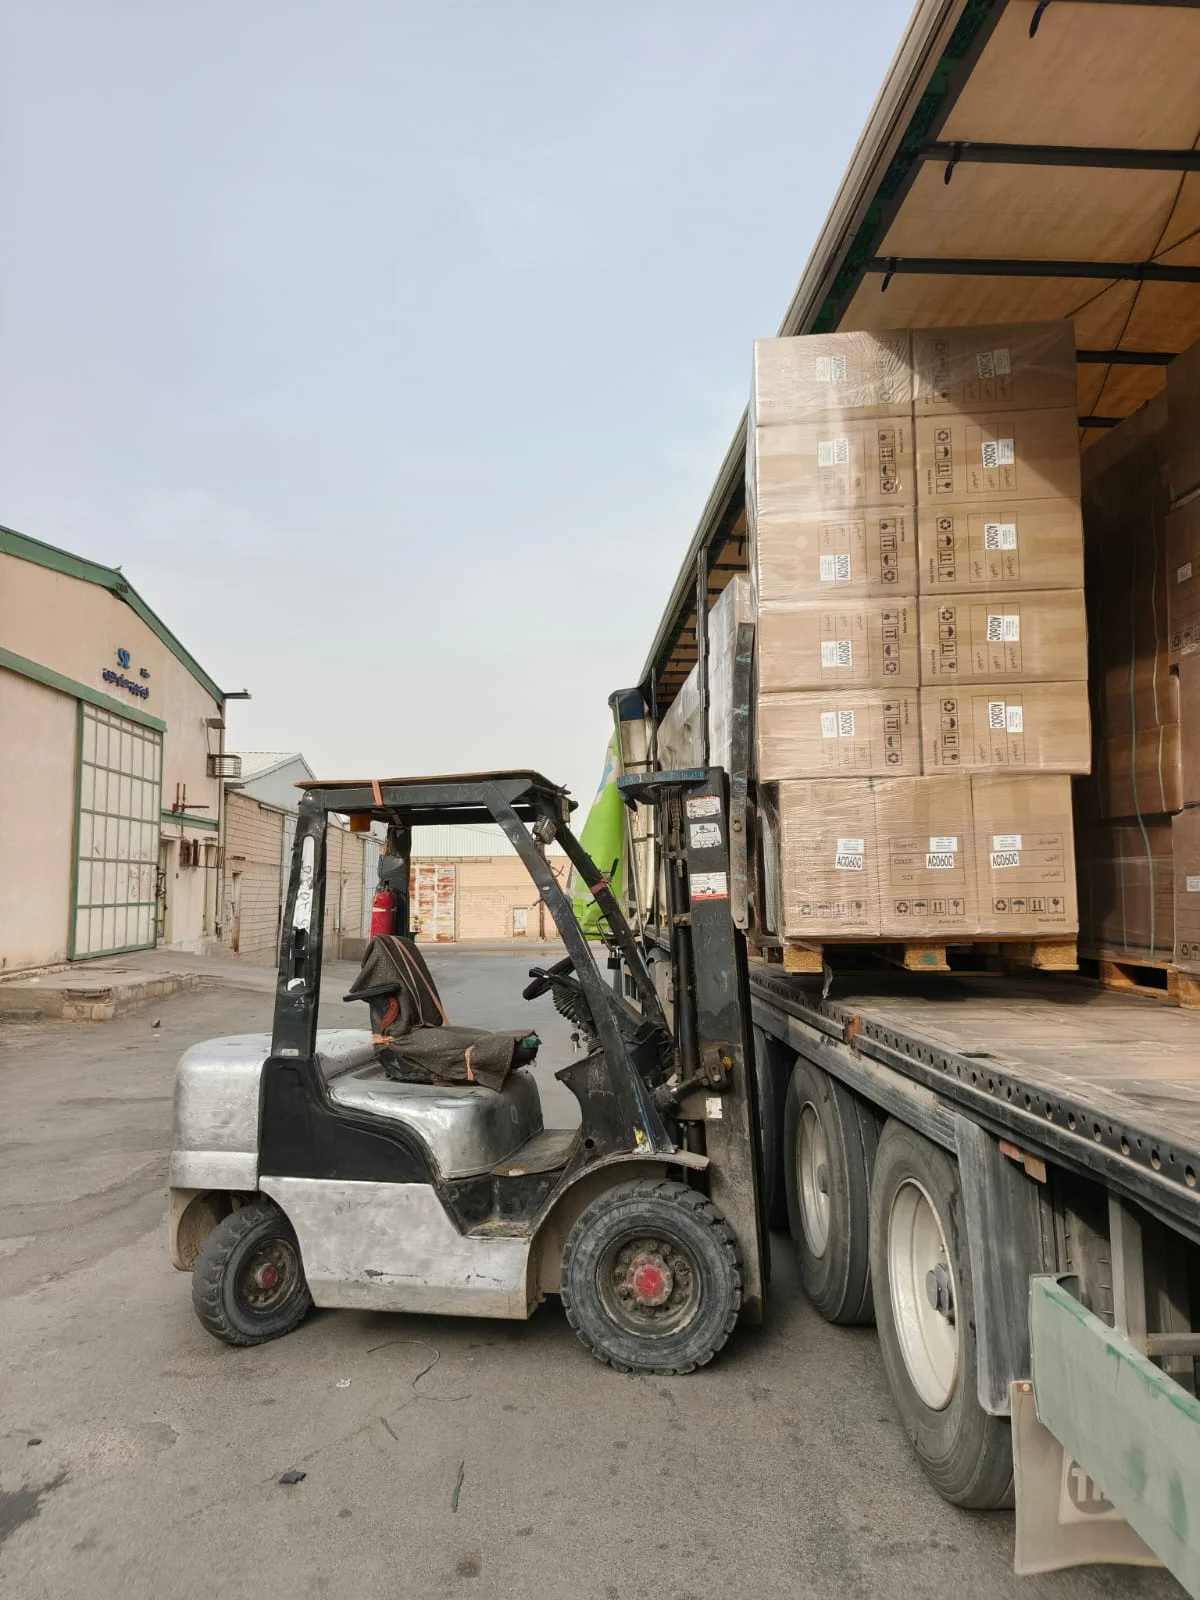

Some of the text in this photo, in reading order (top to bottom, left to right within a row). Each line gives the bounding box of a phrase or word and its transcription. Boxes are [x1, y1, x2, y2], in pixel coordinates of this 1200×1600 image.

[984, 444, 996, 467] AC060C
[986, 525, 999, 549] AC060C
[989, 616, 1002, 640] AC060C
[838, 641, 850, 665] AC060C
[840, 711, 852, 734] AC060C
[990, 703, 1004, 728] AC060C
[928, 855, 952, 867] AC060C
[992, 853, 1018, 867] AC060C
